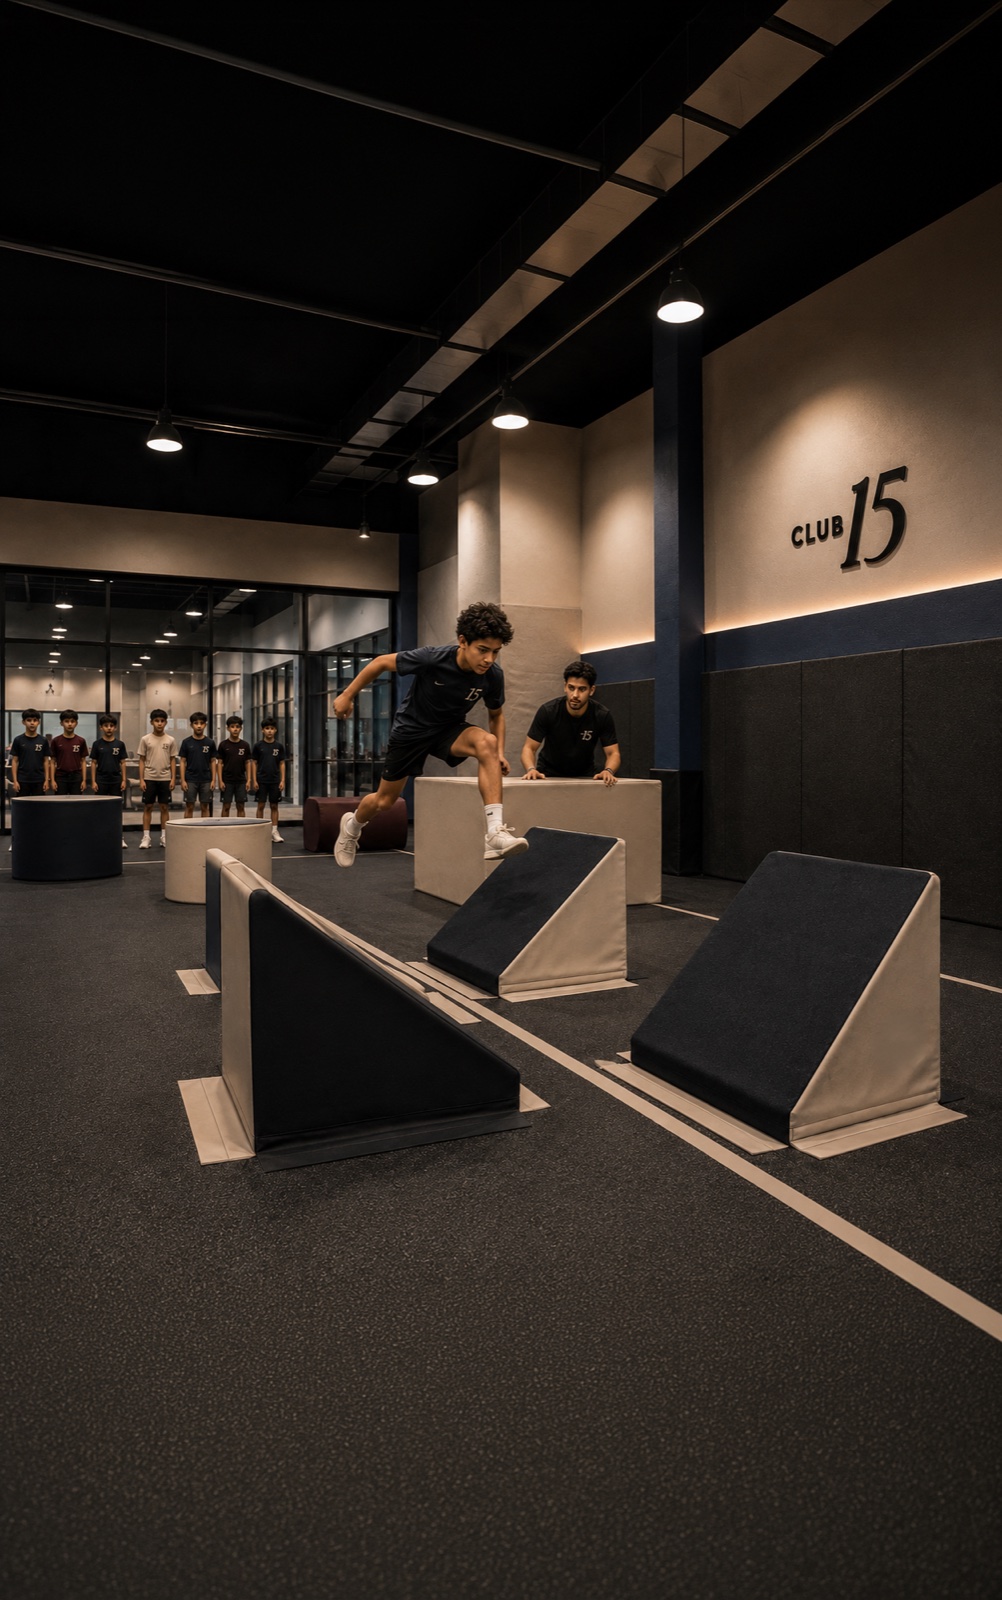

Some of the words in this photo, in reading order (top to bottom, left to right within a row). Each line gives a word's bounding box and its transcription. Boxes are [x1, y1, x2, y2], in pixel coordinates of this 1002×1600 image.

[791, 515, 844, 548] CLUB
[840, 465, 908, 571] 15
[465, 688, 482, 701] 15
